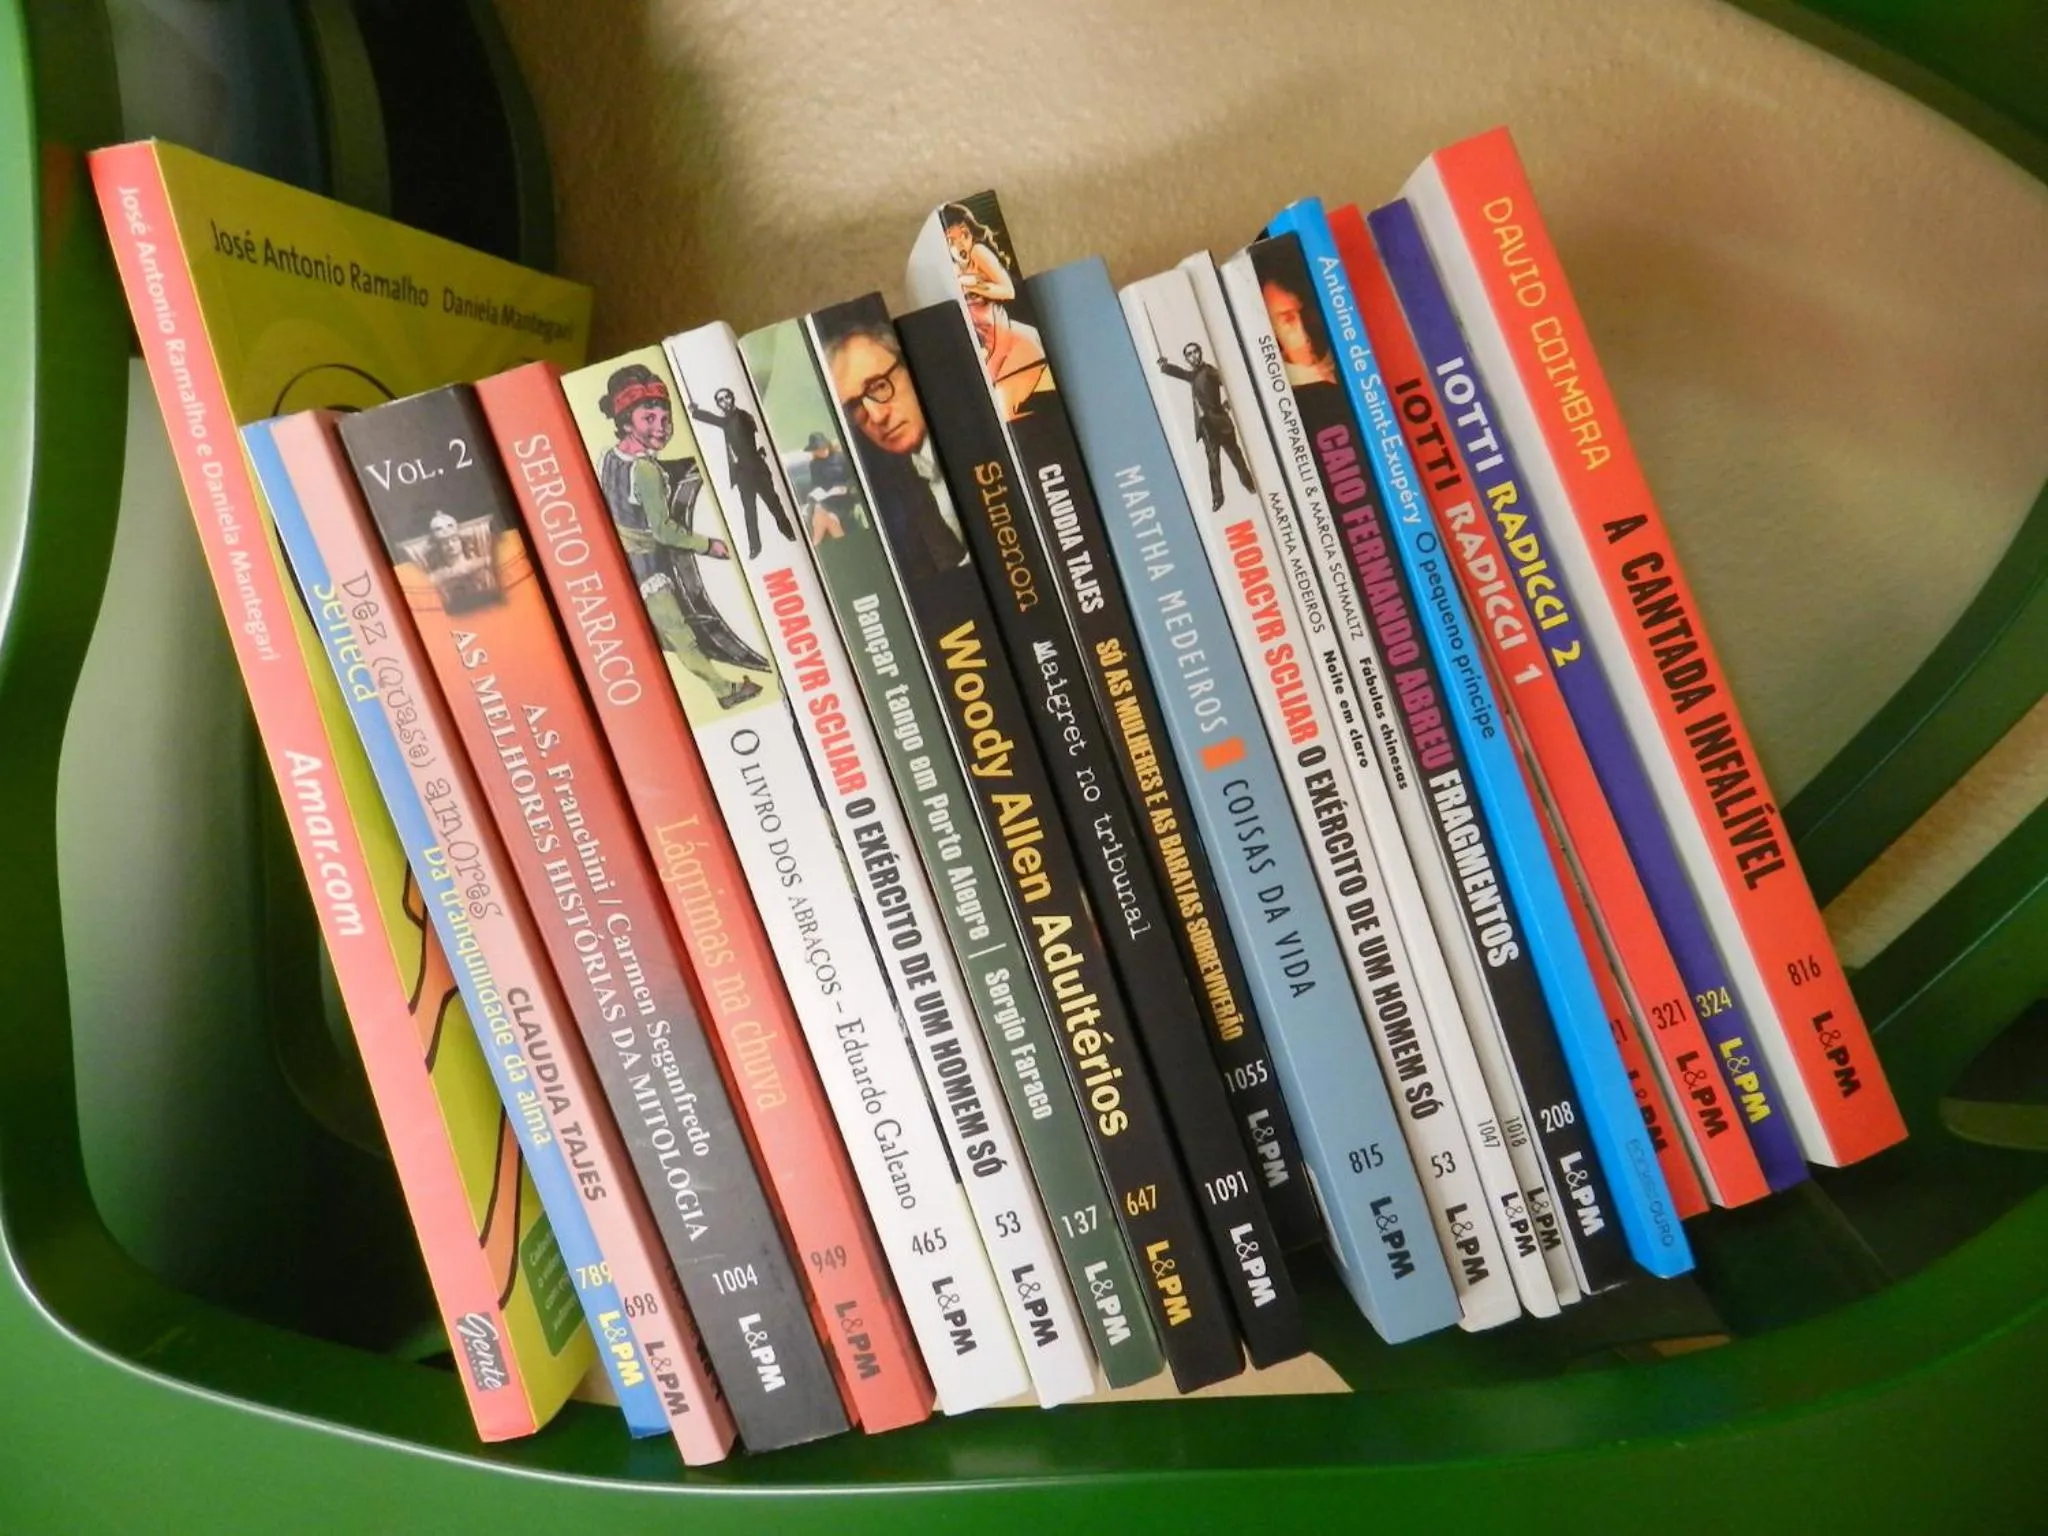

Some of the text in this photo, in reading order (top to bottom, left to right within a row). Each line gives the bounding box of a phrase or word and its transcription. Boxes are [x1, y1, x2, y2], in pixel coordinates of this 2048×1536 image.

[211, 218, 430, 307] José Antonio Ramalho
[443, 287, 498, 325] Daniela
[119, 187, 279, 660] José Antonio Ramalho e Daniela Mantegari
[449, 438, 473, 469] 2
[1319, 256, 1494, 738] Antoine de Saint-Exupéry O pequeno príncipe
[1395, 379, 1542, 683] IOTTI RADICCI 1
[1436, 357, 1579, 666] IOTTI RADICCI 2
[513, 434, 640, 704] SERGIO FARACO
[1483, 197, 1787, 889] DAVID COIMBRA A CANTADA INFALÍVEL
[341, 569, 390, 645] Dez
[1269, 492, 1367, 767] MARTHA MEDEIROS Noite em claro
[1278, 397, 1313, 481] CAPPARELLI
[1305, 486, 1317, 497] &
[1329, 562, 1363, 640] SCHMALTZ
[1359, 657, 1384, 718] Fábulas
[1380, 723, 1407, 789] chinesas
[974, 461, 1150, 939] Simenon Maigret no tribunal
[1115, 465, 1315, 997] MARTHA MEDEIROS COISAS DA VIDA
[1317, 424, 1518, 966] CAIO FERNANDO ABREU FRAGMENTOS
[1038, 463, 1243, 1039] CLAUDIA TAJES SÓ AS MULHERES E AS BARATAS SOBREVIVERÃO
[284, 750, 363, 935] Amar.com
[852, 593, 1051, 1119] Dançar tango em Porto Alegre Sergio Faraco
[1225, 519, 1443, 1119] MOACYR SCLIAR O EXÉRCITO DE UM HOMEM SÓ
[763, 567, 1007, 1177] MOACYR SCLIAR O EXÉRCITO DE UM HOMEM SÓ
[939, 620, 1127, 1135] Woody Allen Adultérios
[451, 631, 707, 1240] AS MELHORES HISTÓRIAS DA MITOLOGIA
[521, 705, 709, 1155] A.S. Franchini Carmen Seganfredo
[655, 815, 789, 1110] Lágrimas na chuva
[730, 729, 915, 1209] O LIVRO DOS ABRAÇOS Eduardo Galeano
[1787, 955, 1821, 985] 816
[1652, 999, 1686, 1029] 321
[1696, 986, 1731, 1016] 324
[505, 986, 607, 1201] CLAUDIA TAJES
[1225, 1059, 1267, 1091] 1055
[1676, 1051, 1727, 1137] L&PM
[1720, 1037, 1770, 1122] L&PM
[1813, 1011, 1860, 1097] L&PM
[503, 1053, 529, 1082] da
[517, 1084, 557, 1144] alma
[1478, 1119, 1500, 1147] 1047
[1502, 1117, 1526, 1150] 1018
[1540, 1101, 1574, 1132] 208
[1205, 1171, 1248, 1204] 1091
[1247, 1108, 1288, 1186] L&PM
[1349, 1143, 1383, 1173] 815
[1431, 1151, 1455, 1178] 53
[995, 1210, 1020, 1237] 53
[1061, 1205, 1096, 1237] 137
[1126, 1184, 1155, 1215] 647
[1501, 1192, 1536, 1257] L&PM
[1527, 1183, 1560, 1251] L&PM
[1560, 1151, 1604, 1236] L&PM
[576, 1257, 615, 1290] 789
[810, 1245, 846, 1272] 949
[912, 1227, 946, 1255] 465
[1230, 1223, 1275, 1307] L&PM
[1370, 1196, 1414, 1279] L&PM
[1445, 1203, 1488, 1285] L&PM
[618, 1289, 658, 1326] 698
[712, 1264, 757, 1294] 1004
[932, 1276, 976, 1355] L&PM
[1012, 1264, 1058, 1346] L&PM
[1084, 1261, 1130, 1345] L&PM
[1146, 1240, 1191, 1325] L&PM
[456, 1312, 504, 1391] Gente
[598, 1309, 644, 1386] L&PM
[644, 1339, 689, 1415] L&PM
[738, 1313, 785, 1391] L&PM
[835, 1300, 880, 1379] L&PM
